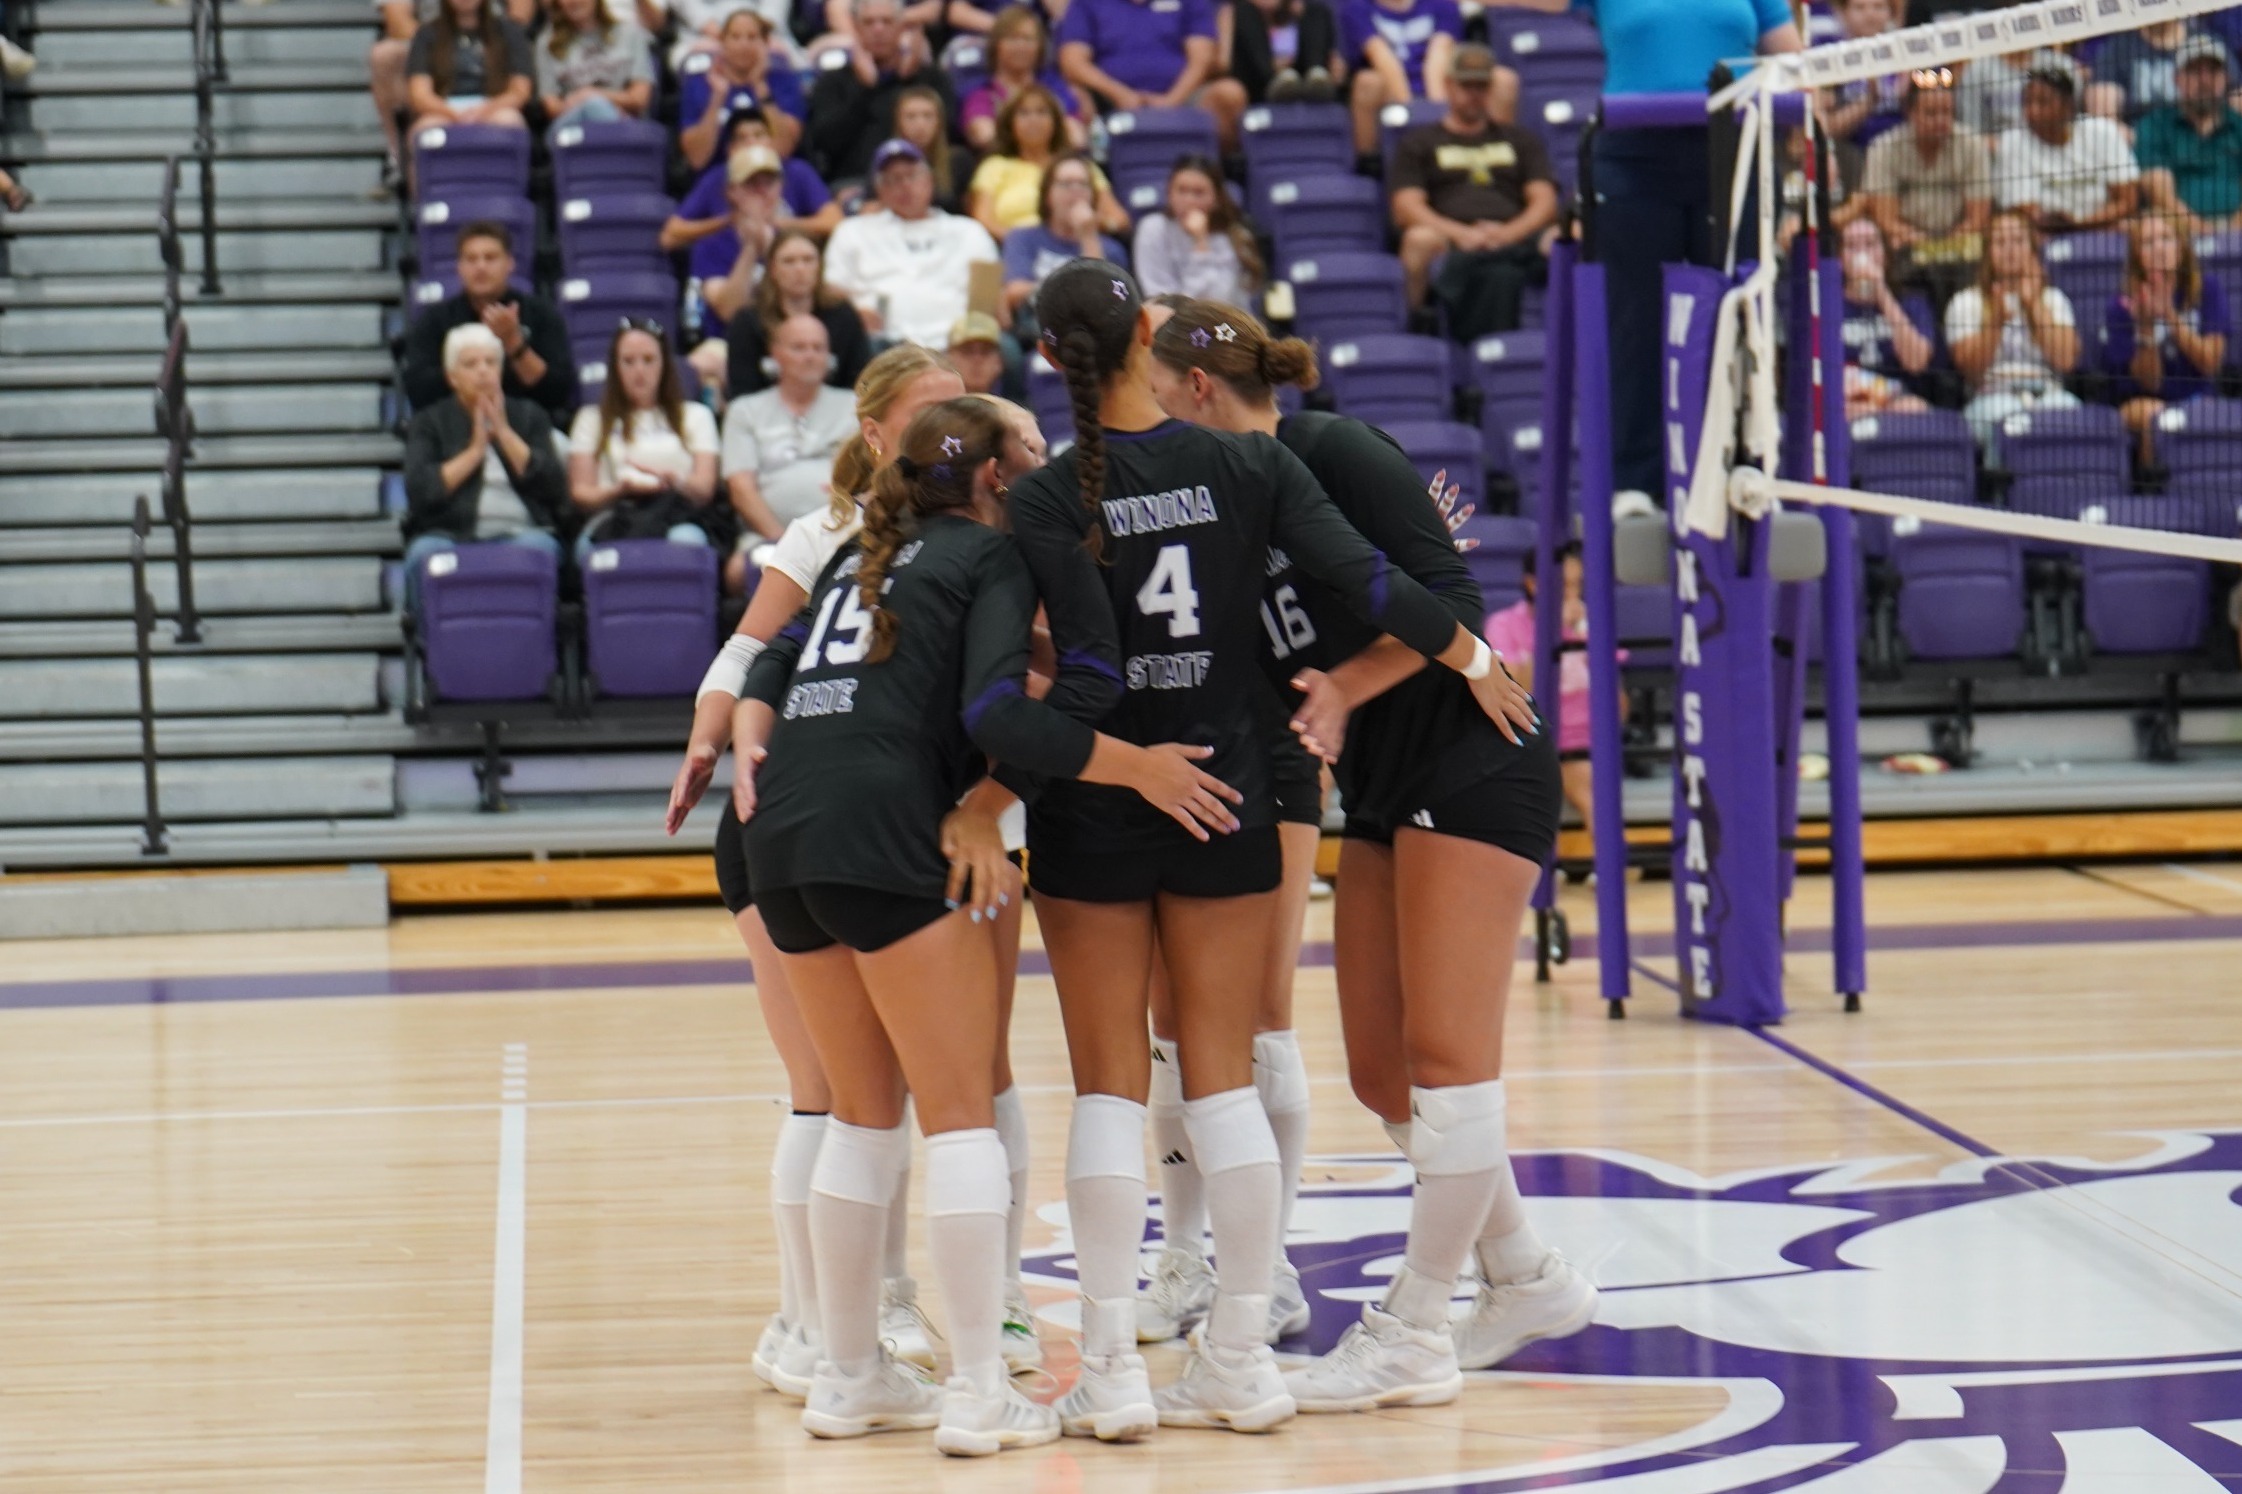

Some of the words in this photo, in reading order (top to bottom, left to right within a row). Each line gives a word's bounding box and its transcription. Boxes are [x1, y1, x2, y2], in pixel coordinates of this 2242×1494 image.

[1101, 485, 1218, 537] WINONA
[1667, 293, 1701, 667] WINONA
[797, 577, 894, 672] 15
[1136, 544, 1200, 638] 4
[1260, 584, 1317, 660] 16
[783, 677, 859, 720] STATE
[1683, 692, 1712, 999] STATE
